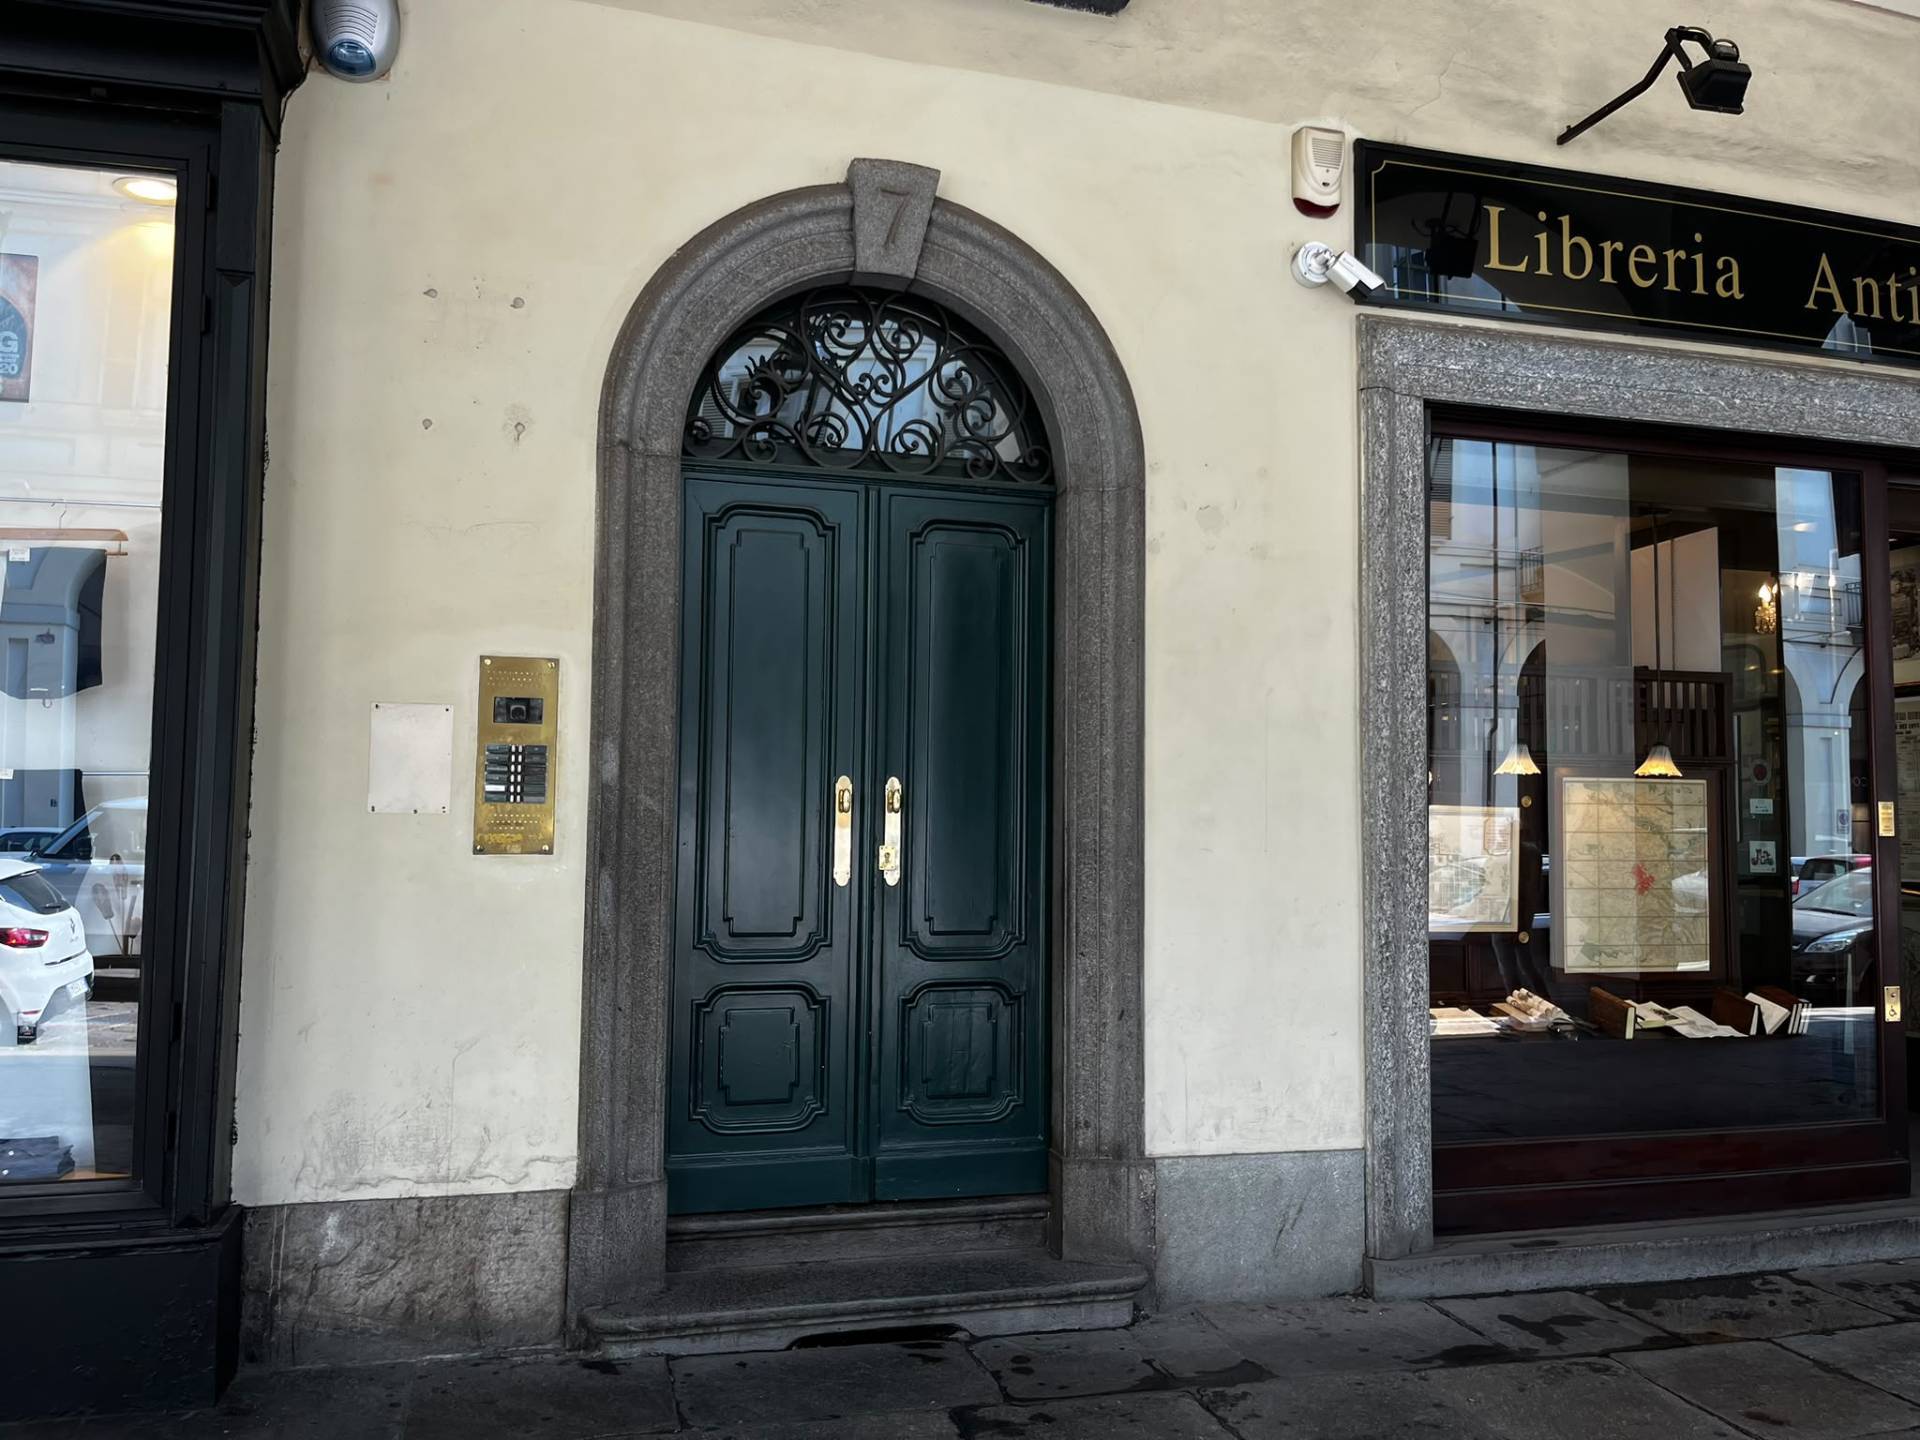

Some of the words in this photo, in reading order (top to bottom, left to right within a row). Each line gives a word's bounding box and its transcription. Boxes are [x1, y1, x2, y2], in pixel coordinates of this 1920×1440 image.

[880, 188, 912, 250] 7
[1482, 204, 1745, 300] Libreria
[1804, 252, 1920, 325] Anti
